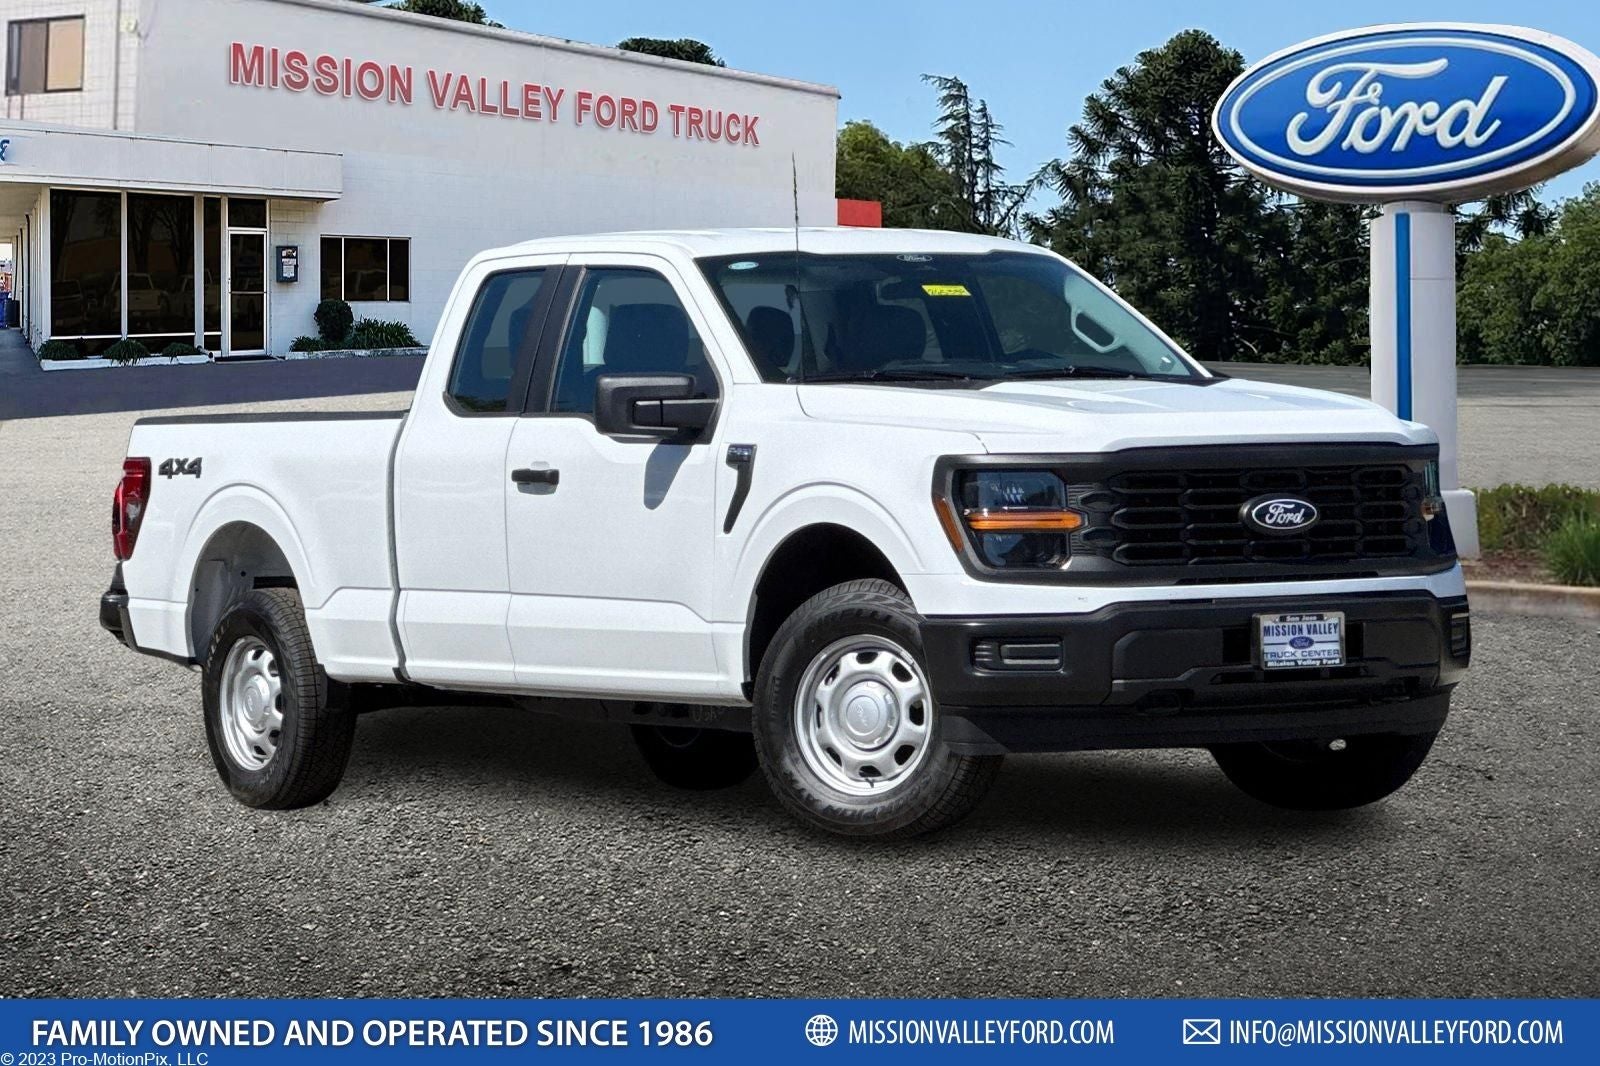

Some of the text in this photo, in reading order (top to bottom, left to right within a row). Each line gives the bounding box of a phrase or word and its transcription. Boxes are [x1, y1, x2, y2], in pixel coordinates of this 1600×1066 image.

[230, 42, 760, 146] MISSION VALLEY FORD TRUCK
[1286, 58, 1509, 156] Ford
[1265, 503, 1305, 524] Ford
[1264, 623, 1338, 637] MISSION VALLEY
[1293, 638, 1309, 647] Ford
[1264, 649, 1340, 659] TRUCK CENTER
